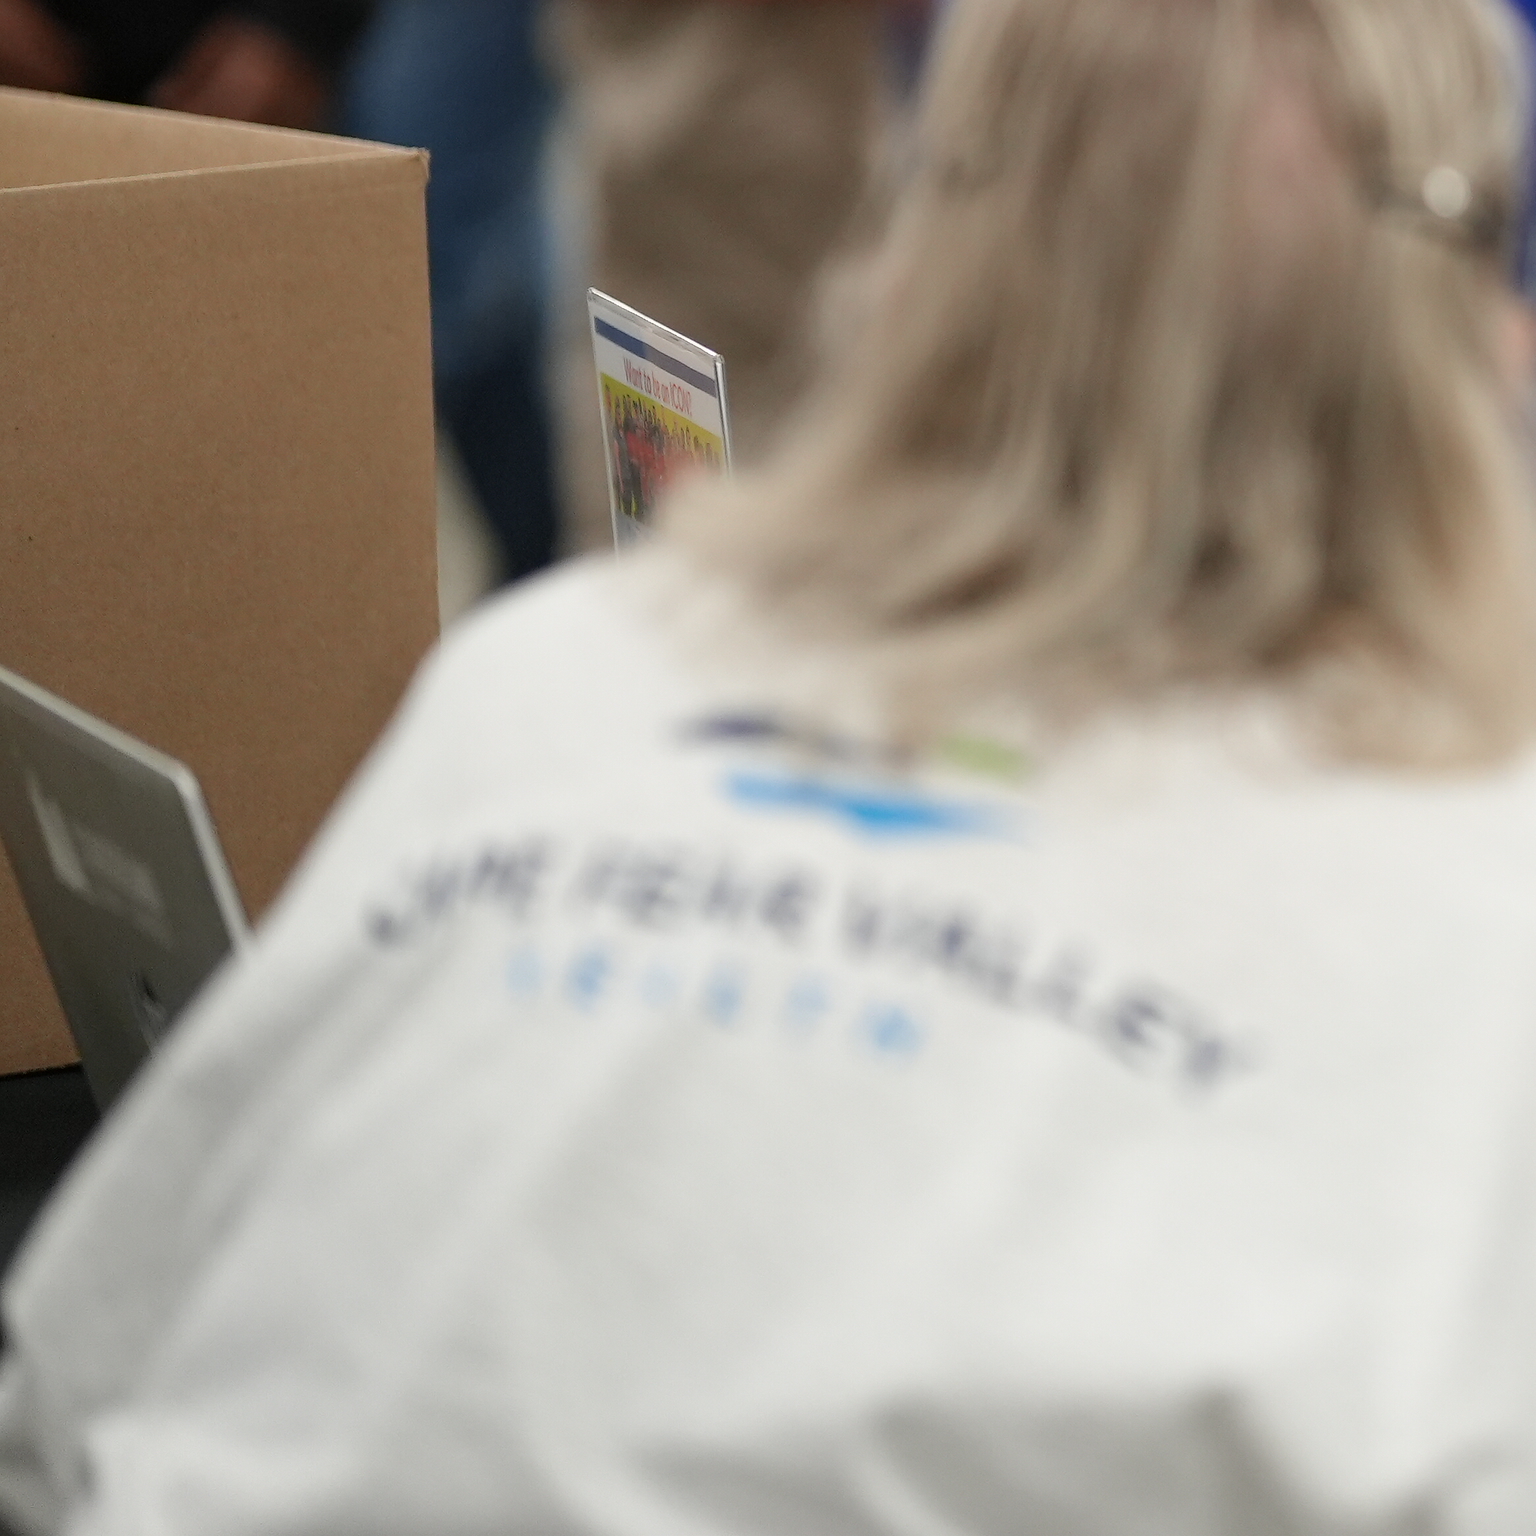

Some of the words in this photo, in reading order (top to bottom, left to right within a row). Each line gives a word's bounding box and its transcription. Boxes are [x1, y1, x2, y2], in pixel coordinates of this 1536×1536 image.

[623, 358, 643, 390] Want
[643, 369, 652, 394] to
[652, 371, 661, 399] be
[661, 383, 671, 404] an
